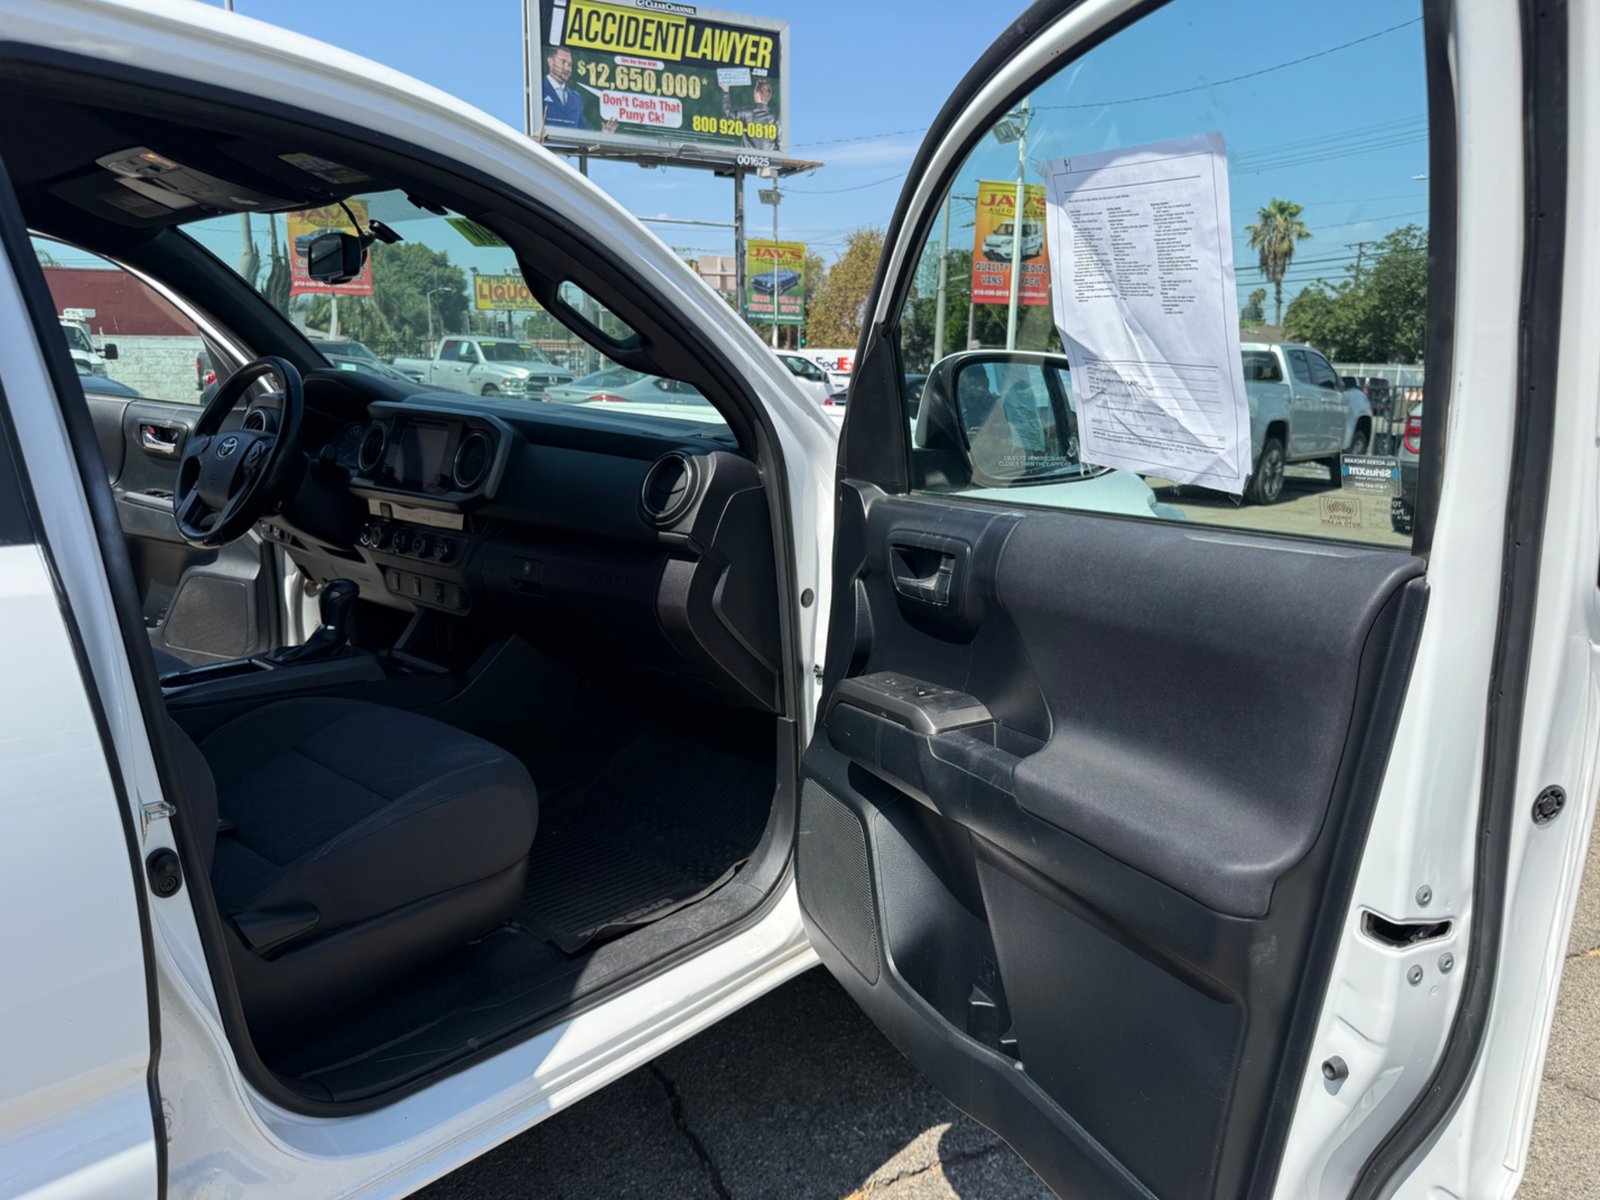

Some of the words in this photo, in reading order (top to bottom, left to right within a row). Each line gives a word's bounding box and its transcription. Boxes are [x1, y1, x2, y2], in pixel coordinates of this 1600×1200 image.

[568, 7, 684, 55] ACCIDENT
[685, 25, 773, 68] LAWYER
[602, 93, 629, 107] Don't
[632, 97, 656, 110] Cash
[659, 101, 680, 113] That
[619, 108, 645, 123] Puny
[648, 111, 664, 123] Ck!
[693, 115, 717, 133] 800
[719, 118, 776, 139] 920-0810
[737, 154, 770, 167] 001625
[478, 284, 531, 301] LIQUO
[577, 897, 675, 937] TCOMA
